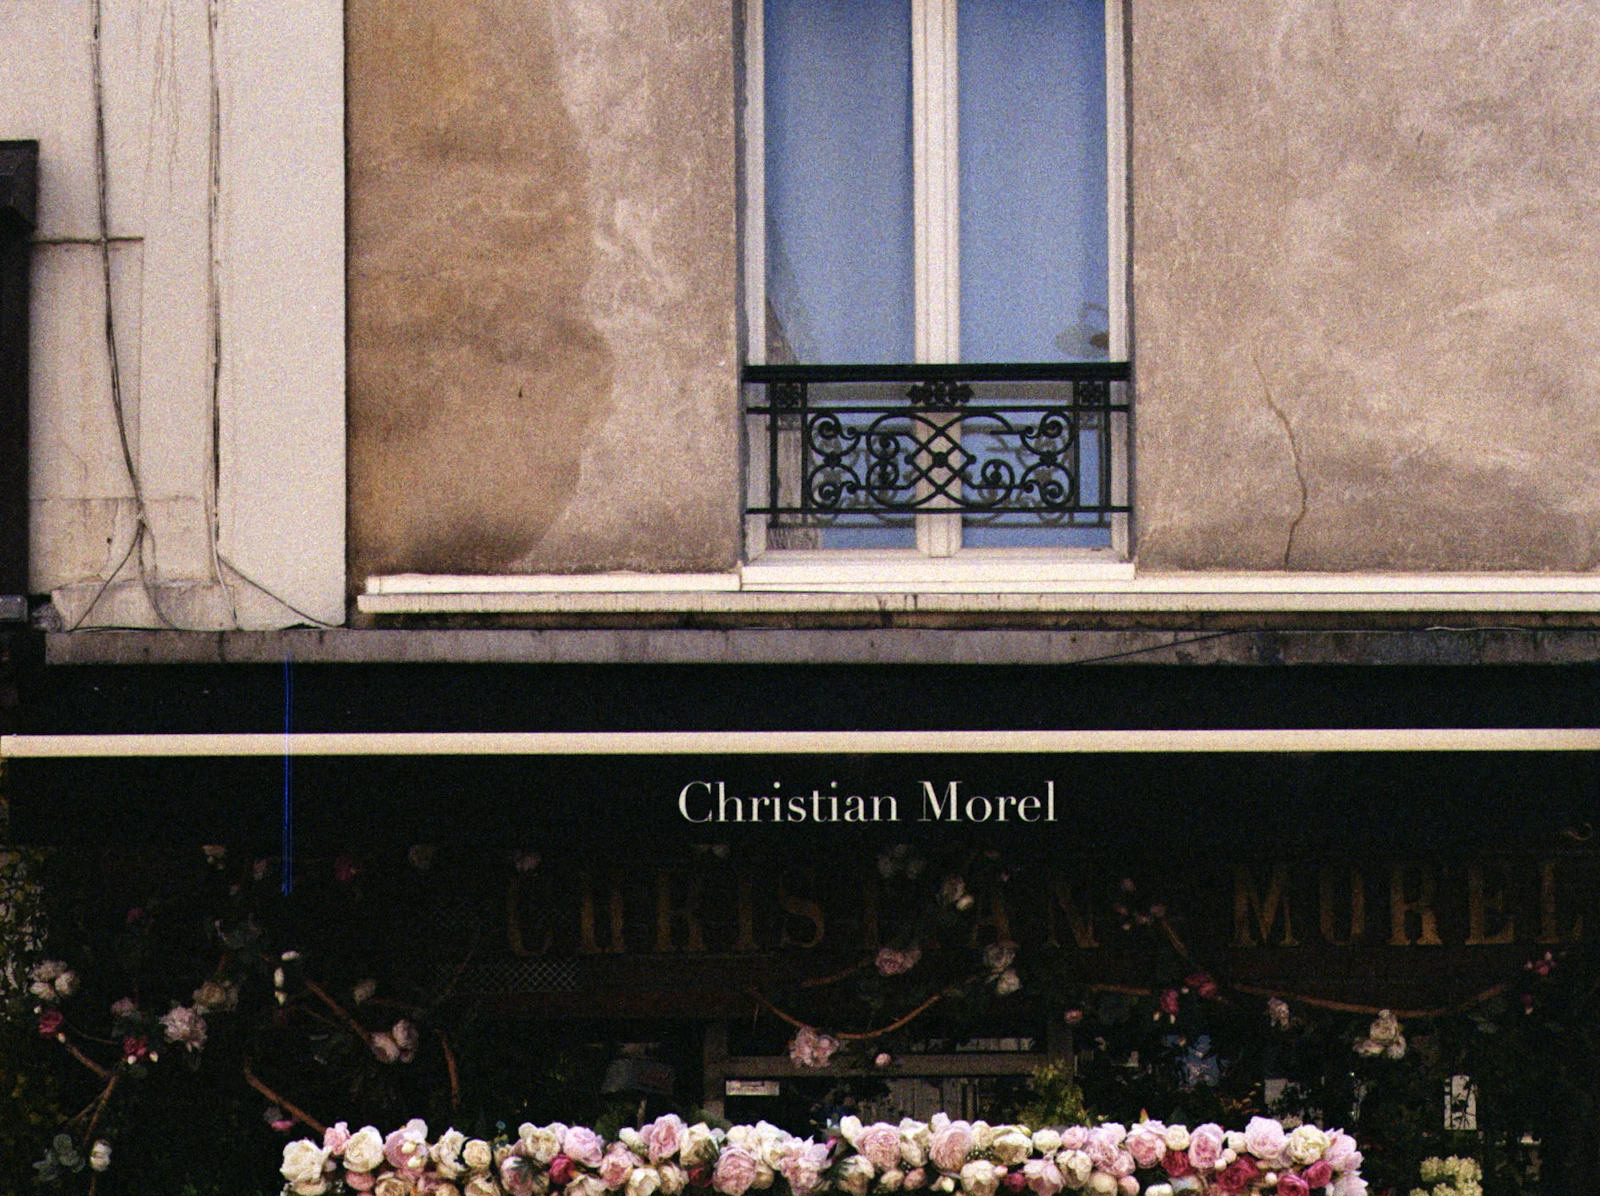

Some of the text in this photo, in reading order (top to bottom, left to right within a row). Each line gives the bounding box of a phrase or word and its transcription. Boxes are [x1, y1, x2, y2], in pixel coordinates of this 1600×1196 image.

[677, 780, 1058, 823] Christian Morel
[505, 860, 1585, 956] CHRISAN MOREL
